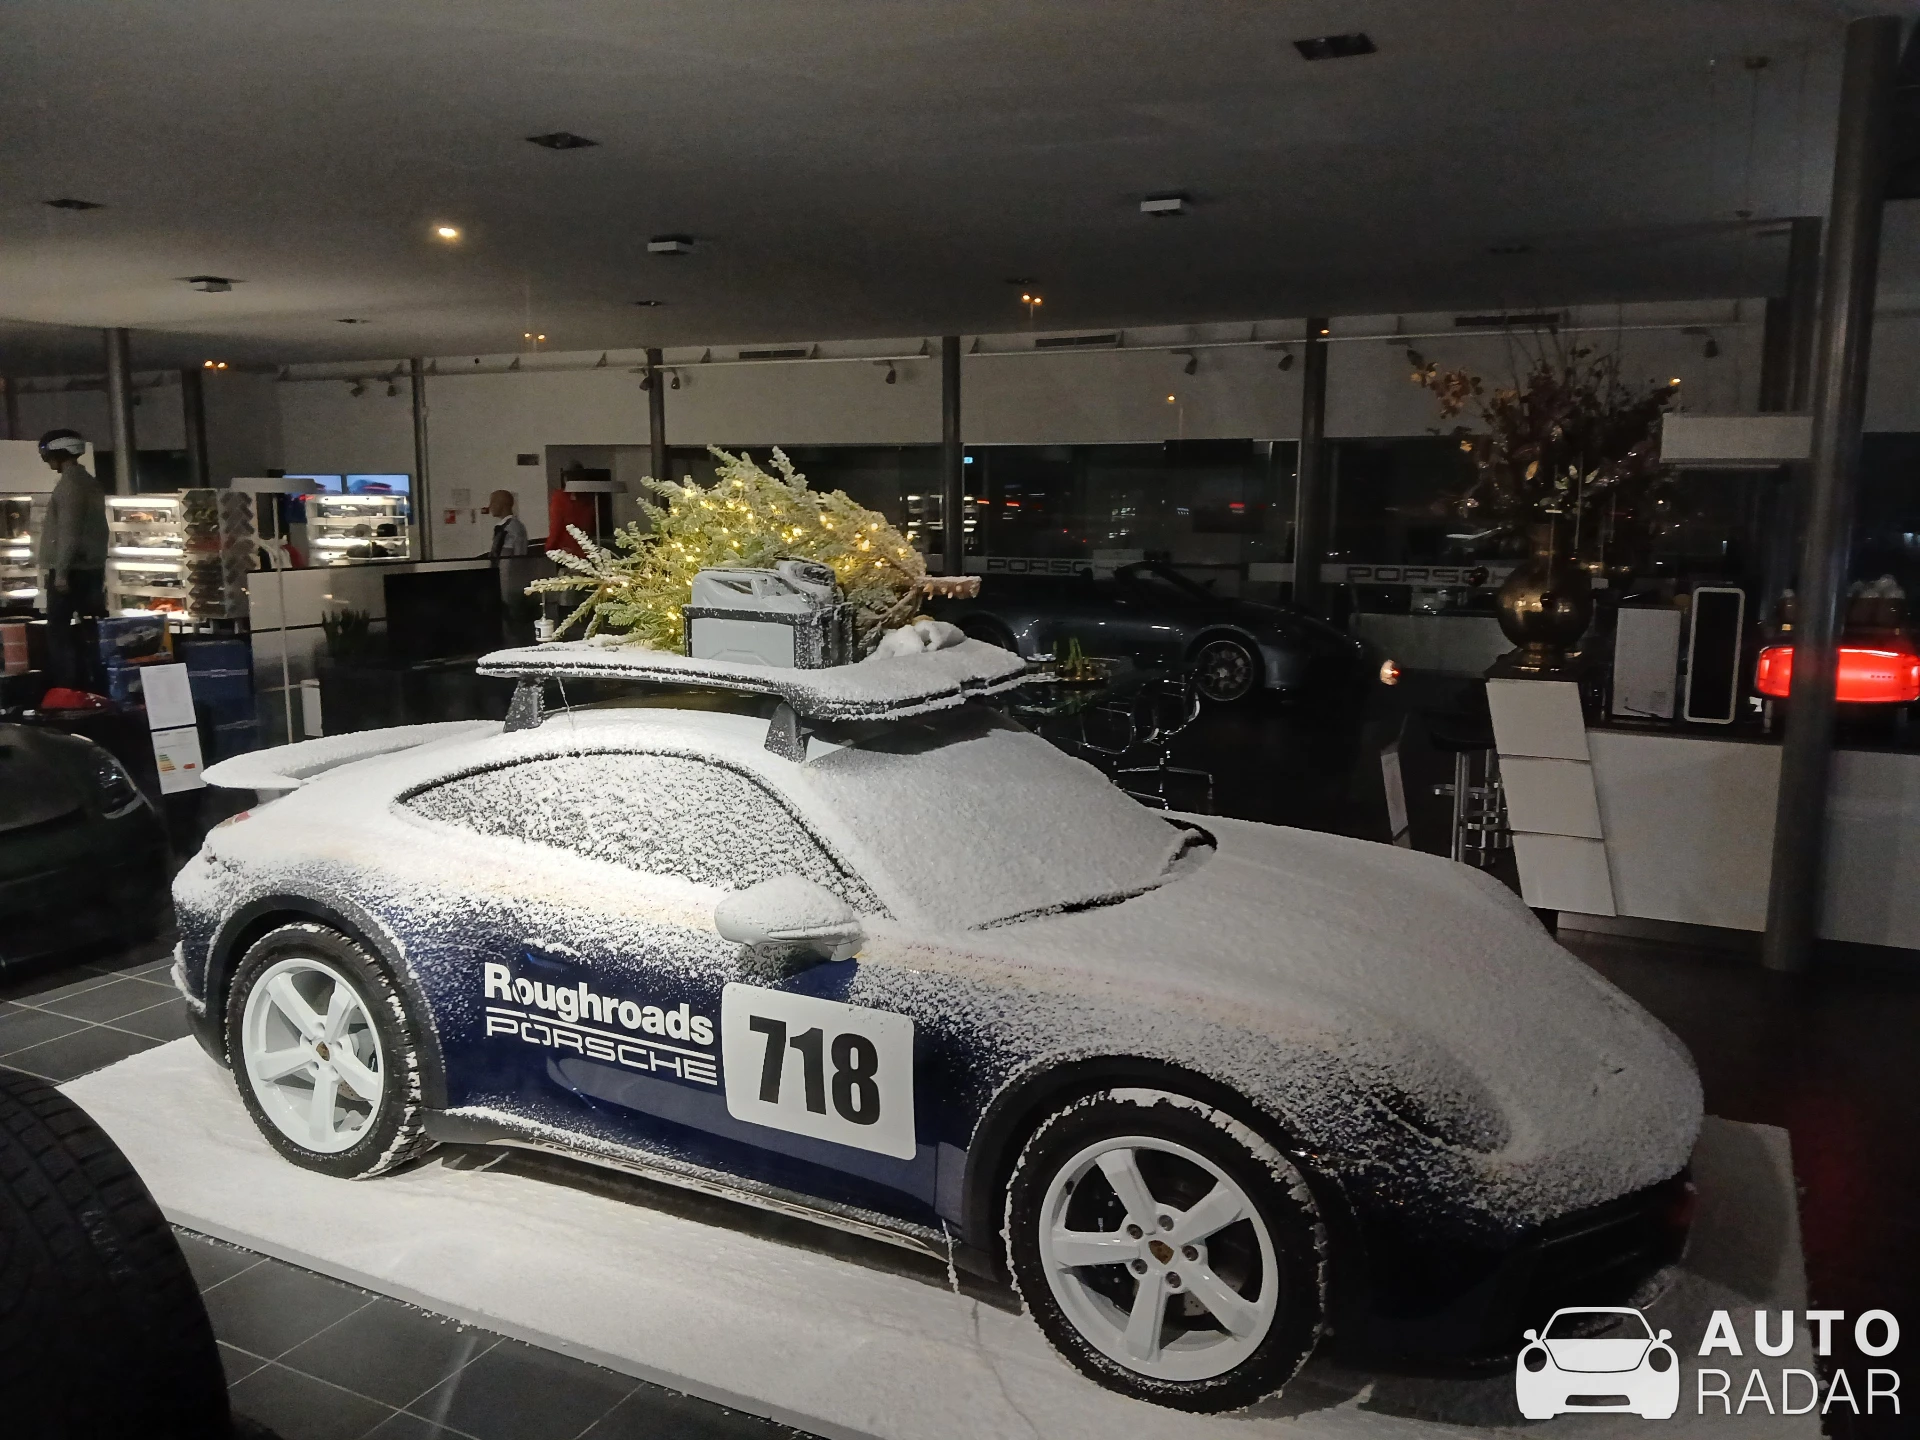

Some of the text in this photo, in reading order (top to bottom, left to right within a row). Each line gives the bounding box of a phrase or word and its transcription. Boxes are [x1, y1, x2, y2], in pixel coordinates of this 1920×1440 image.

[484, 961, 714, 1045] Roughroads
[486, 1015, 718, 1085] PORSCHE
[749, 1014, 881, 1126] 718
